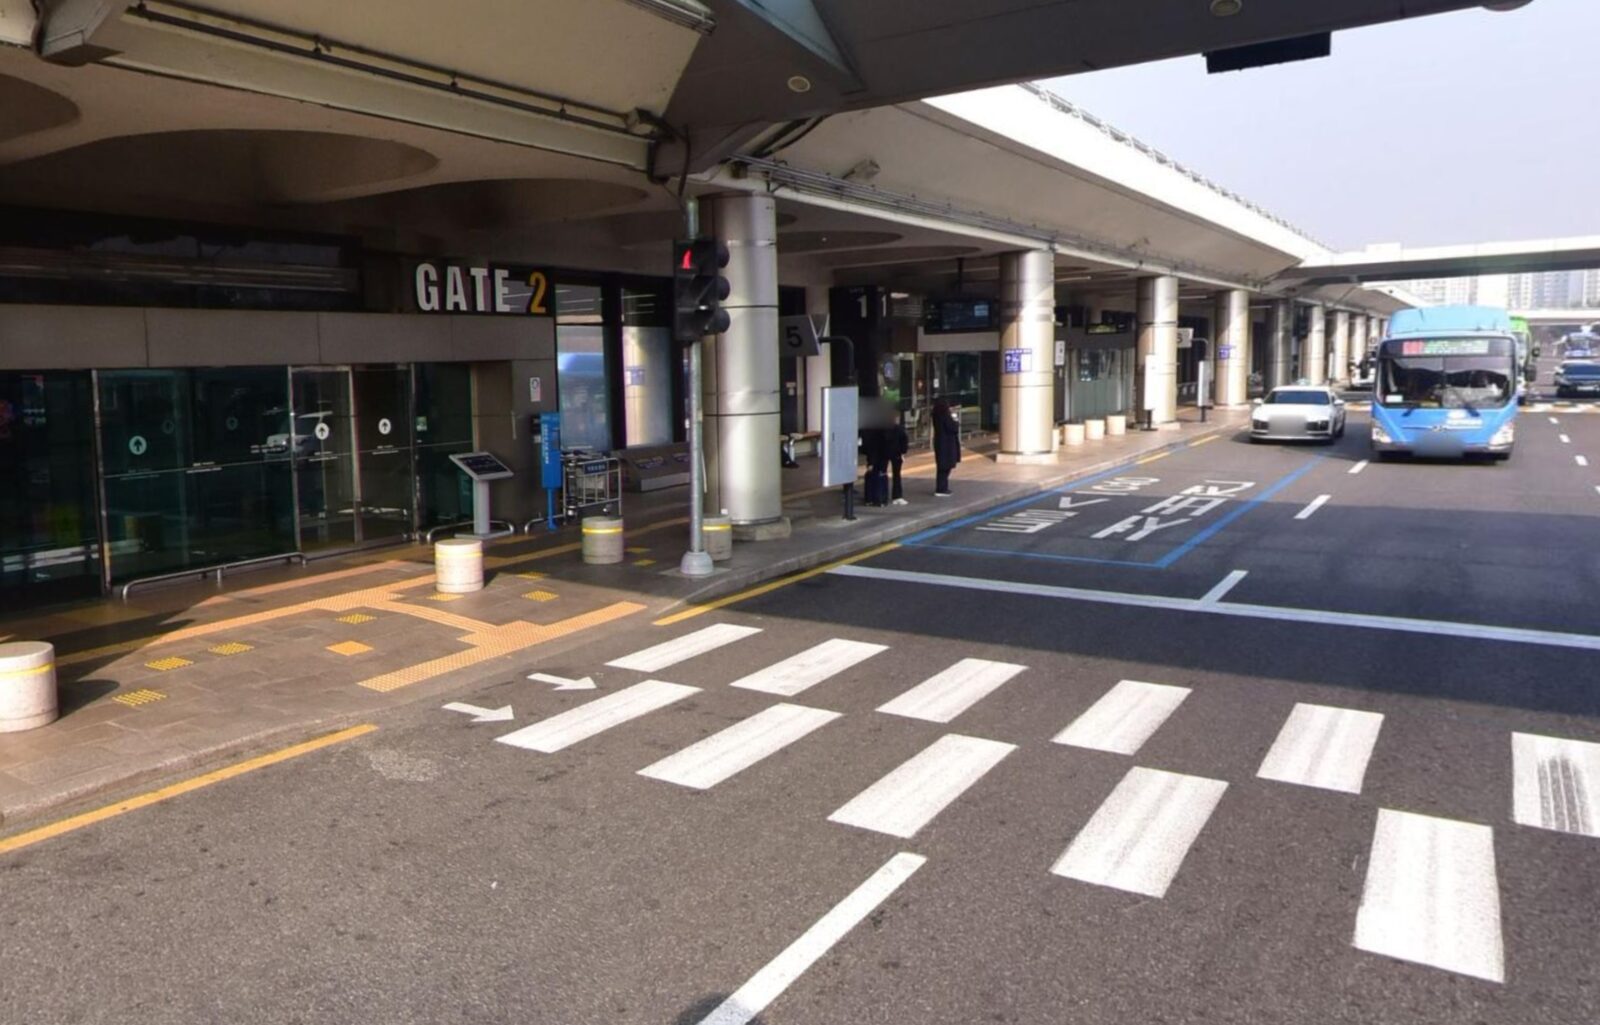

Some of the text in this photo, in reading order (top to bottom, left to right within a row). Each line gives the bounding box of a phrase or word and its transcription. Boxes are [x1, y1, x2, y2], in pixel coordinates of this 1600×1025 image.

[416, 263, 546, 314] GATE 2
[786, 325, 803, 348] 5
